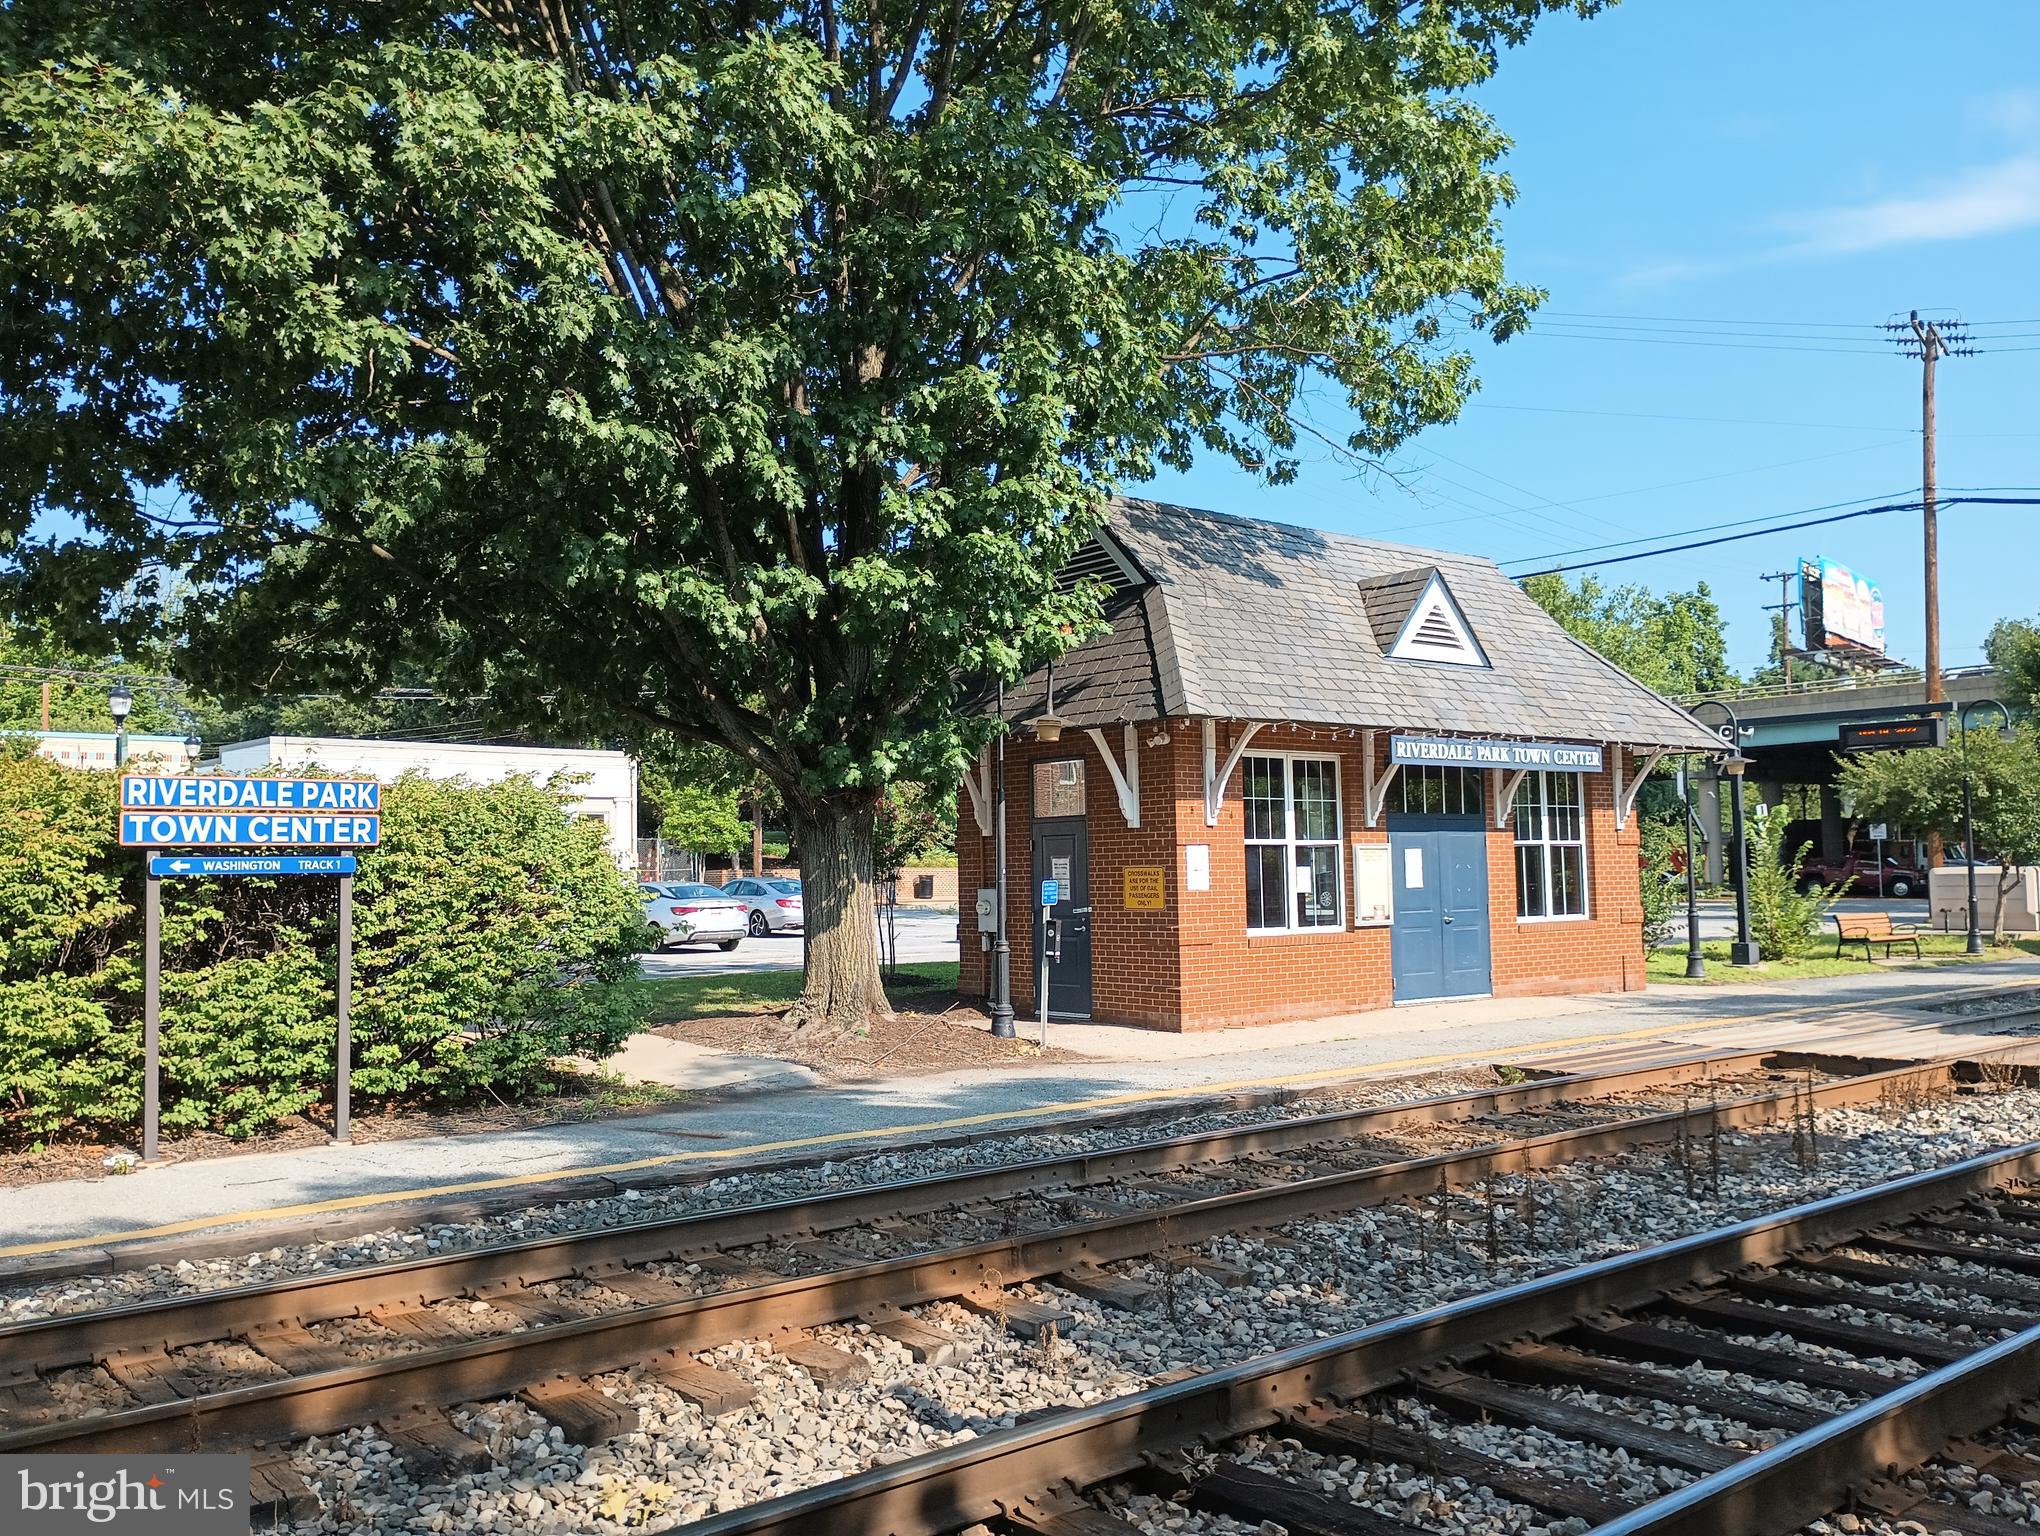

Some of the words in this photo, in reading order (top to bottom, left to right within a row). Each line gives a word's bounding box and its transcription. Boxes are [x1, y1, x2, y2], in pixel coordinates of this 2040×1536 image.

[1396, 741, 1474, 761] RIVERDALE
[1476, 745, 1511, 762] PARK
[1512, 747, 1550, 764] TOWN
[1554, 749, 1601, 766] CENTER
[128, 778, 293, 807] RIVERDALE
[303, 781, 375, 808] PARK
[129, 815, 237, 843] TOWN
[248, 816, 372, 843] CENTER
[203, 860, 281, 871] WASHINGTON
[298, 860, 333, 870] TRACK
[335, 860, 341, 870] 1
